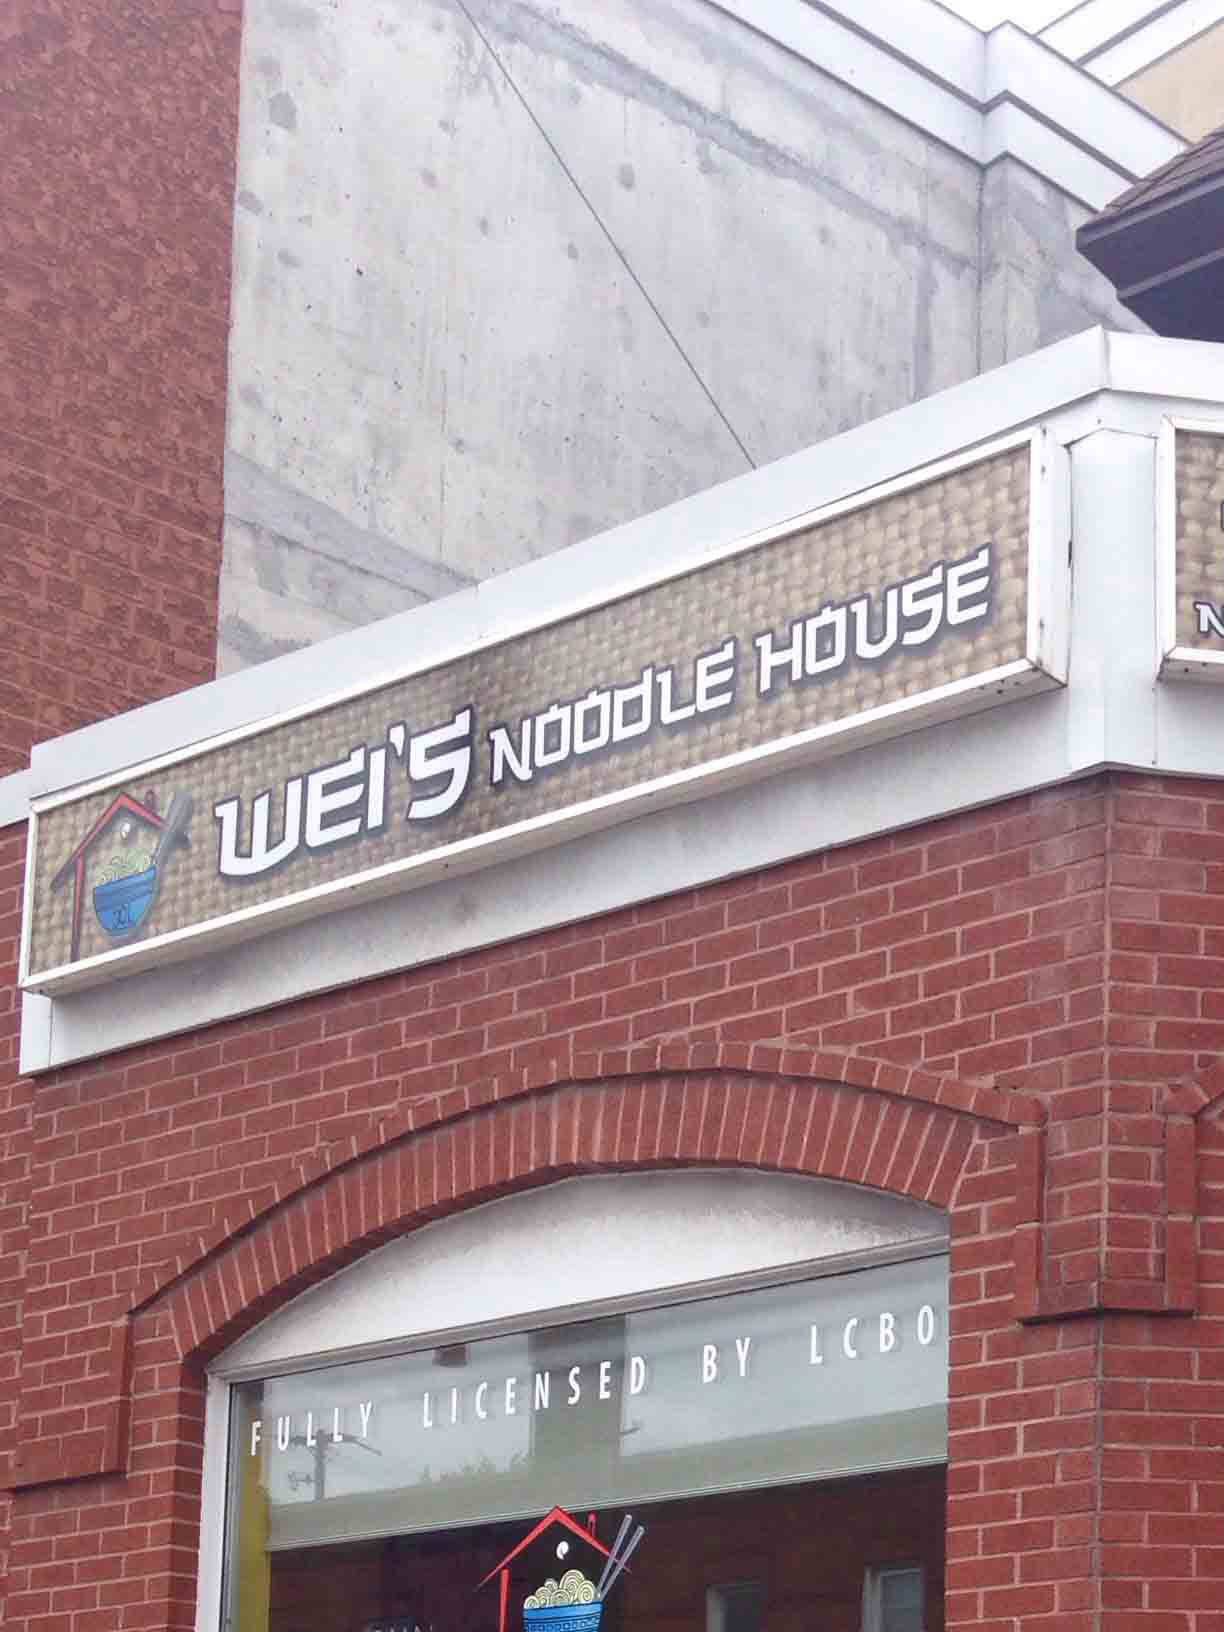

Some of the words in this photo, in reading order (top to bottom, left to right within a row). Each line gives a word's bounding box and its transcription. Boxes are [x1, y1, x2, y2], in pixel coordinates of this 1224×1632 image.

[214, 707, 473, 877] WEI'S
[489, 640, 735, 784] NOODLE
[754, 546, 991, 692] HOUSE
[249, 1401, 374, 1457] FULLY
[422, 1355, 647, 1428] LICENSED
[702, 1336, 754, 1384] BY
[809, 1304, 937, 1366] LCBO
